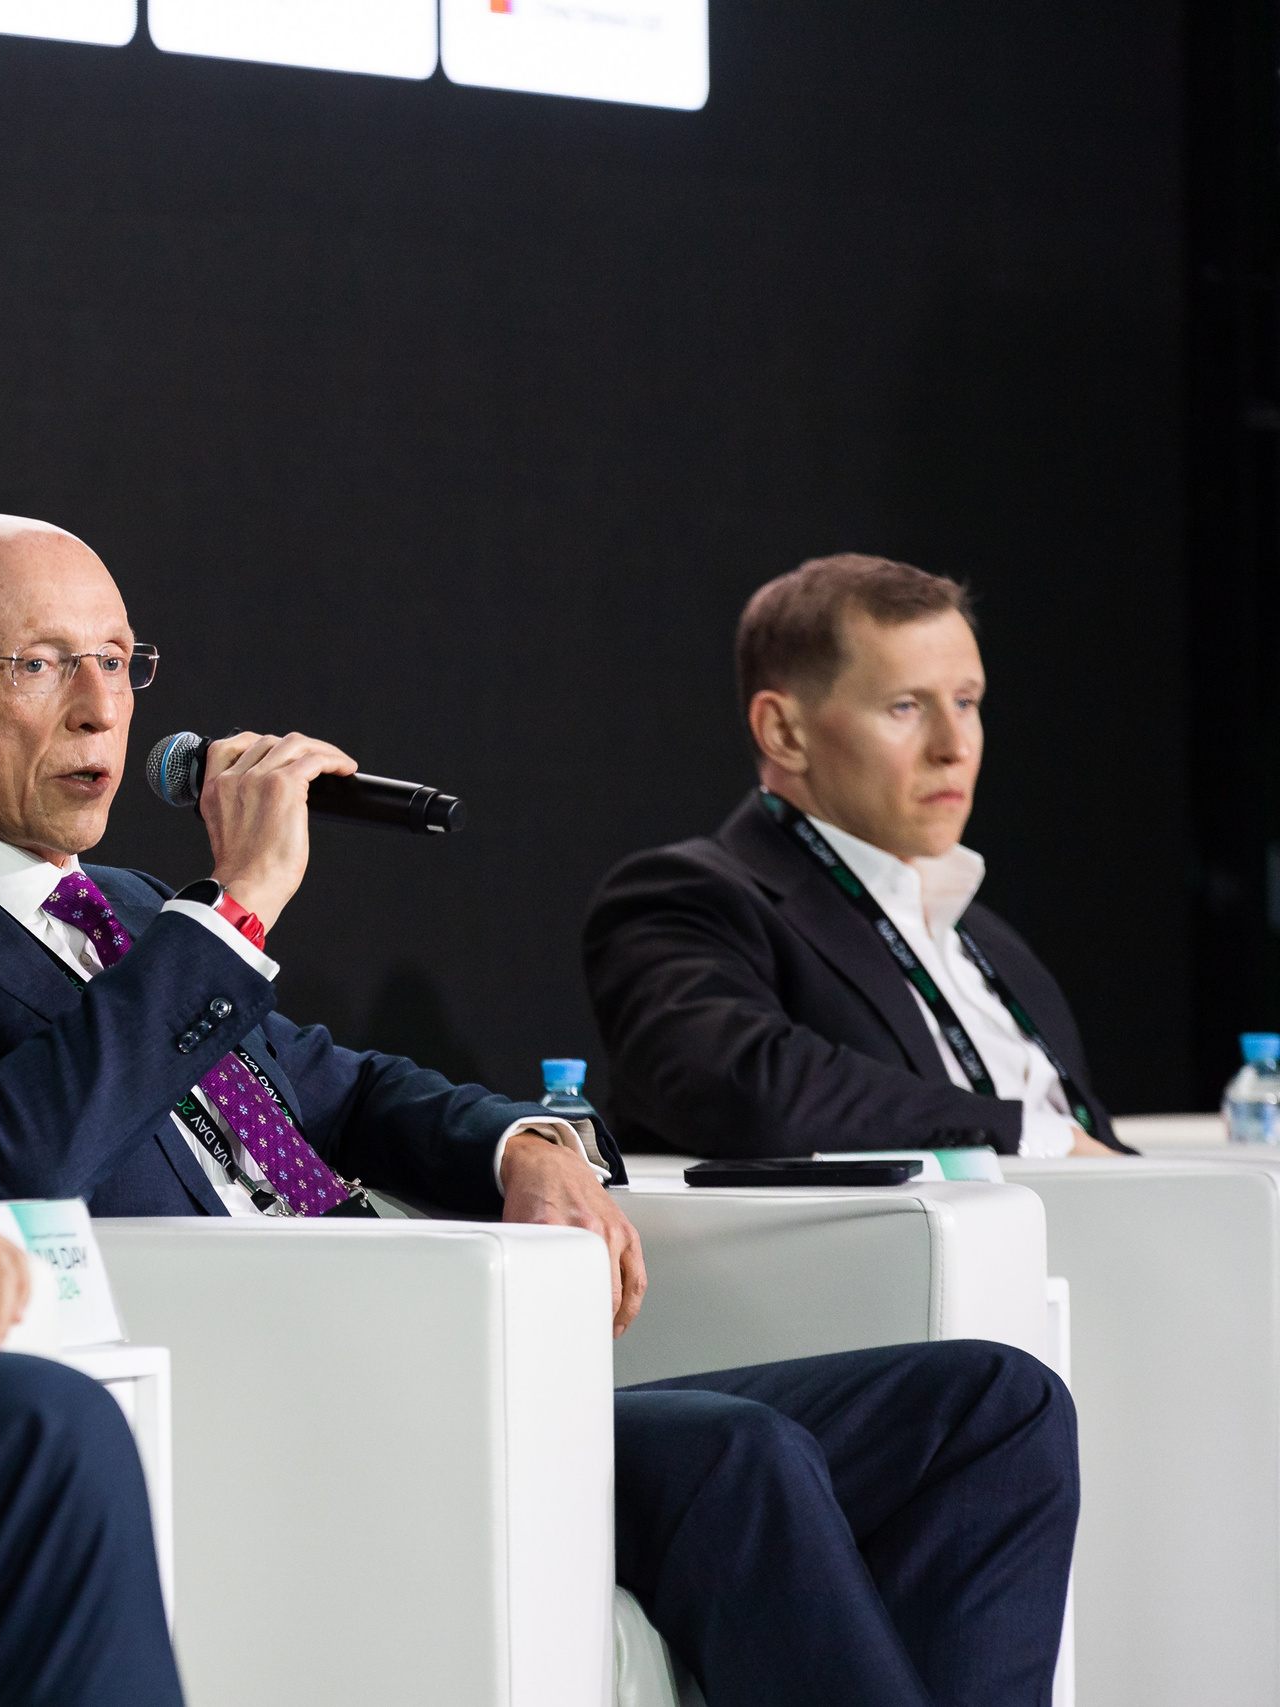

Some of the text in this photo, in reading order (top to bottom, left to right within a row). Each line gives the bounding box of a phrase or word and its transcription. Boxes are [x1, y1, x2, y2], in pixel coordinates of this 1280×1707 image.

[239, 1052, 260, 1073] IVA
[258, 1076, 282, 1104] DAY
[190, 1115, 217, 1145] DAY
[213, 1142, 232, 1169] IVA
[59, 1246, 89, 1270] DAY
